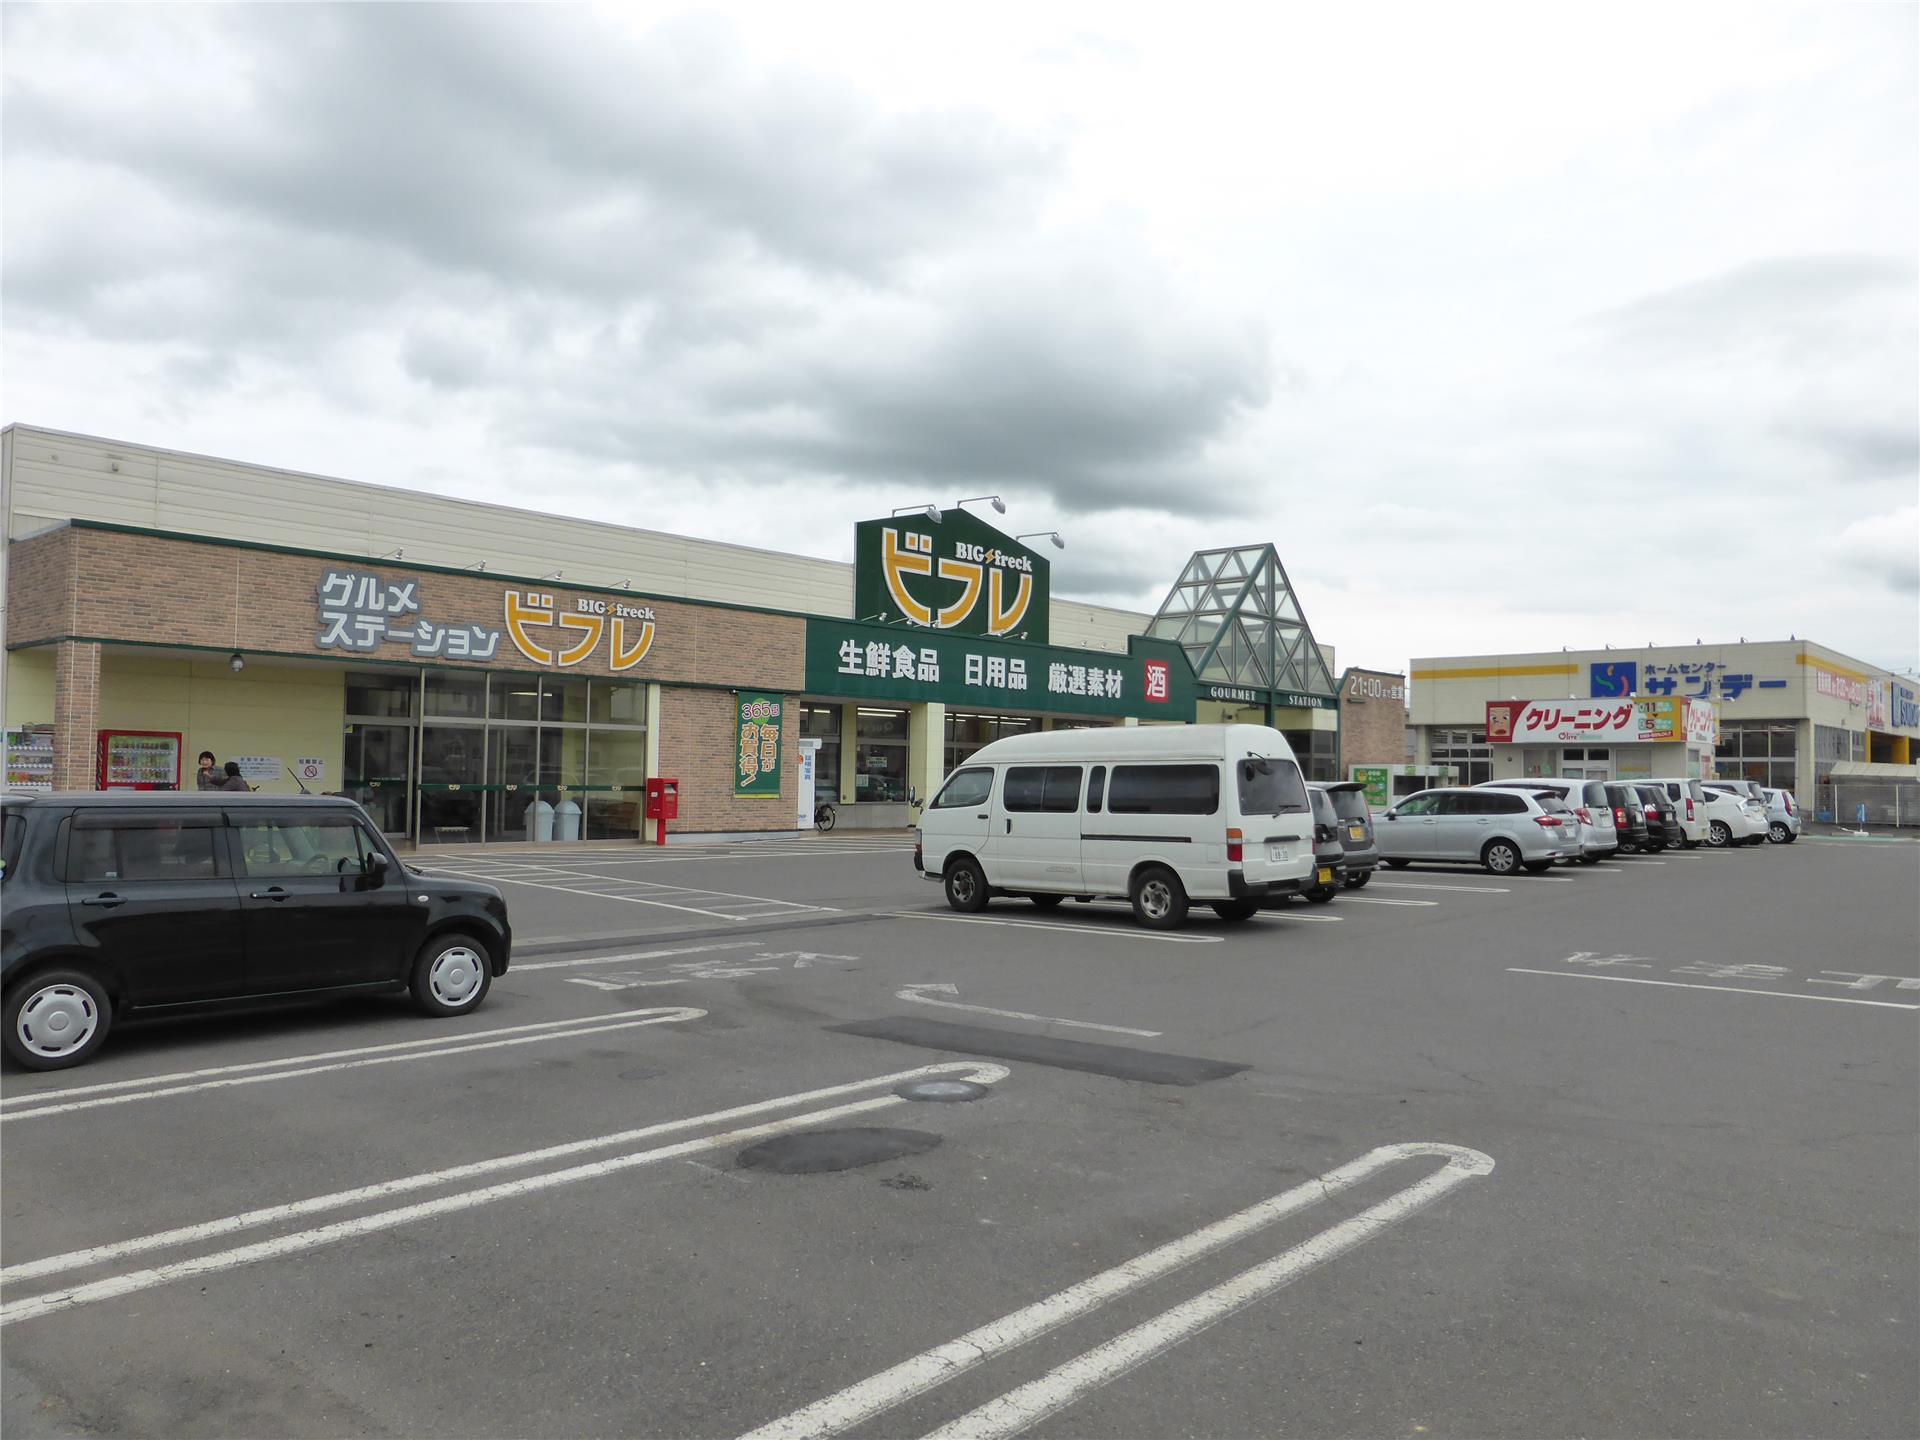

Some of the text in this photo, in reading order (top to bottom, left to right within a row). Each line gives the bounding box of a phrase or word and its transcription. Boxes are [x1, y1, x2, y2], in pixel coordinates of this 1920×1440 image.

[955, 542, 1032, 572] BIG freck
[323, 573, 418, 613] グルメ
[882, 527, 1032, 635] ビフレ
[577, 598, 655, 620] BIG freck
[321, 612, 499, 657] ステーション
[505, 590, 656, 671] ビフレ
[838, 639, 1166, 698] 生鮮食品 日用品 厳選素材 酒
[1645, 662, 1726, 675] ホームセンター
[1210, 686, 1323, 708] GOURMET STATION
[1645, 674, 1787, 700] サンデー
[742, 701, 779, 719] 365日
[1526, 703, 1633, 731] クリーニング
[760, 724, 779, 772] 毎日が
